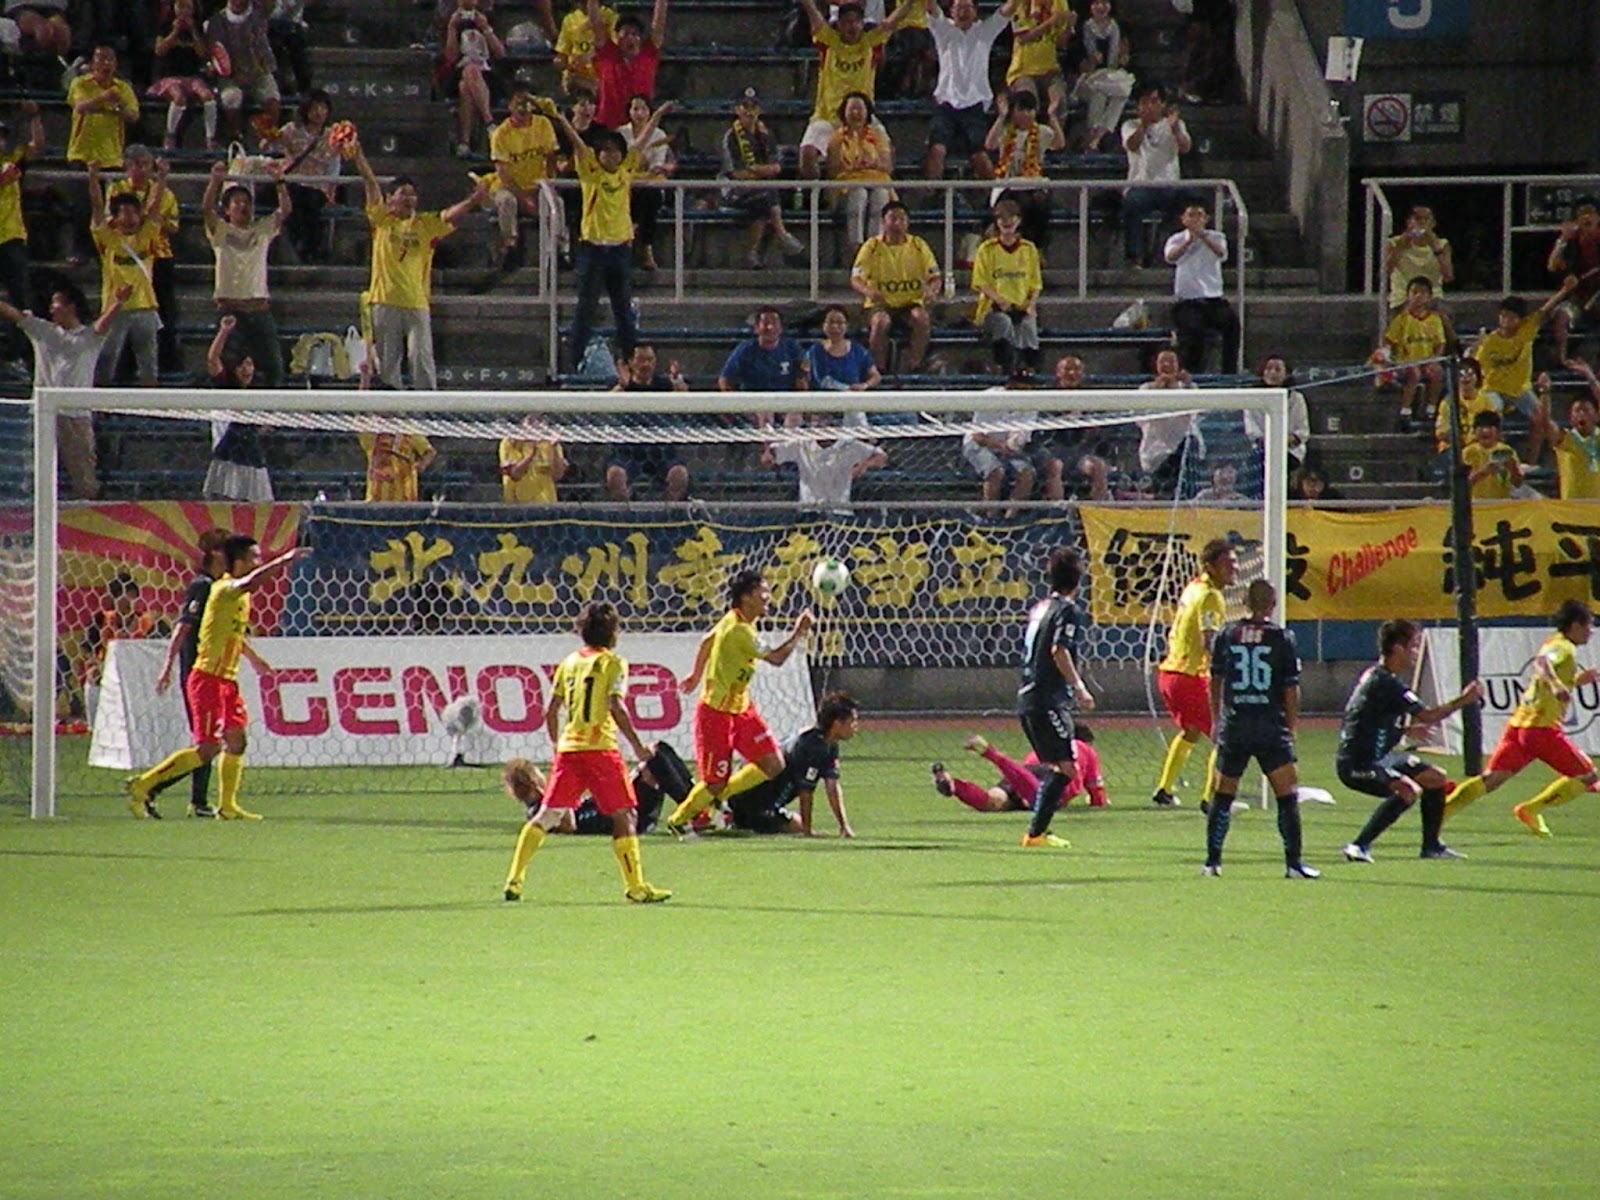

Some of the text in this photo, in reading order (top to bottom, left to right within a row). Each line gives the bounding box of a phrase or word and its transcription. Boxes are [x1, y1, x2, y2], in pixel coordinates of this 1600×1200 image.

[365, 83, 377, 96] K
[383, 136, 395, 152] J
[480, 368, 490, 381] F
[1328, 417, 1340, 431] E
[1325, 526, 1418, 596] Challenge
[1229, 645, 1272, 690] 36
[716, 761, 728, 778] 3
